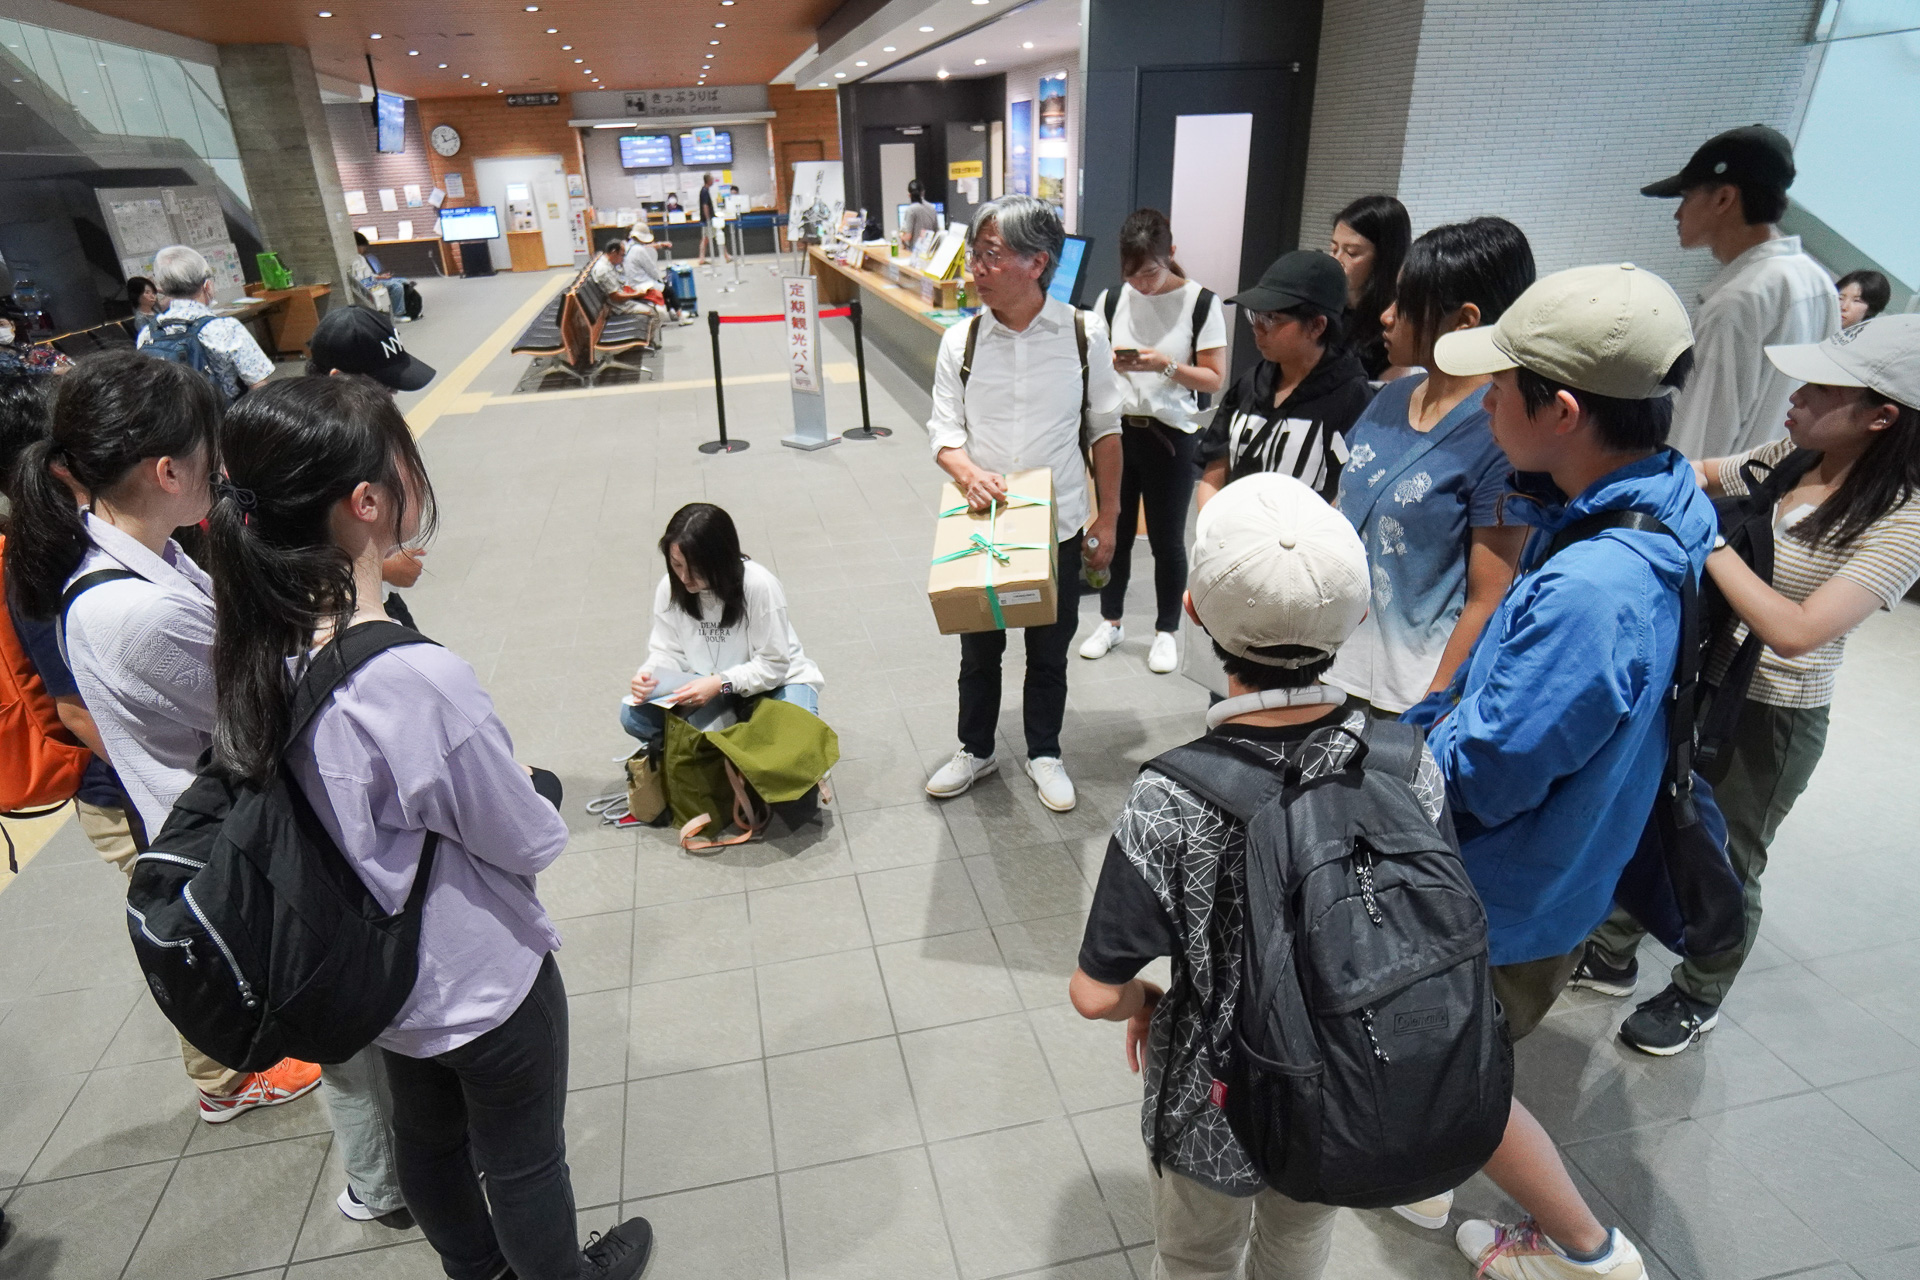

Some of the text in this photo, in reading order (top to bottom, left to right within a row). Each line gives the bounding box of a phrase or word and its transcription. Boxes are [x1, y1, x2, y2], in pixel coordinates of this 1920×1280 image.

[652, 89, 719, 104] きっぷうりば
[789, 284, 809, 376] 定期観光バス
[710, 628, 730, 636] FERA
